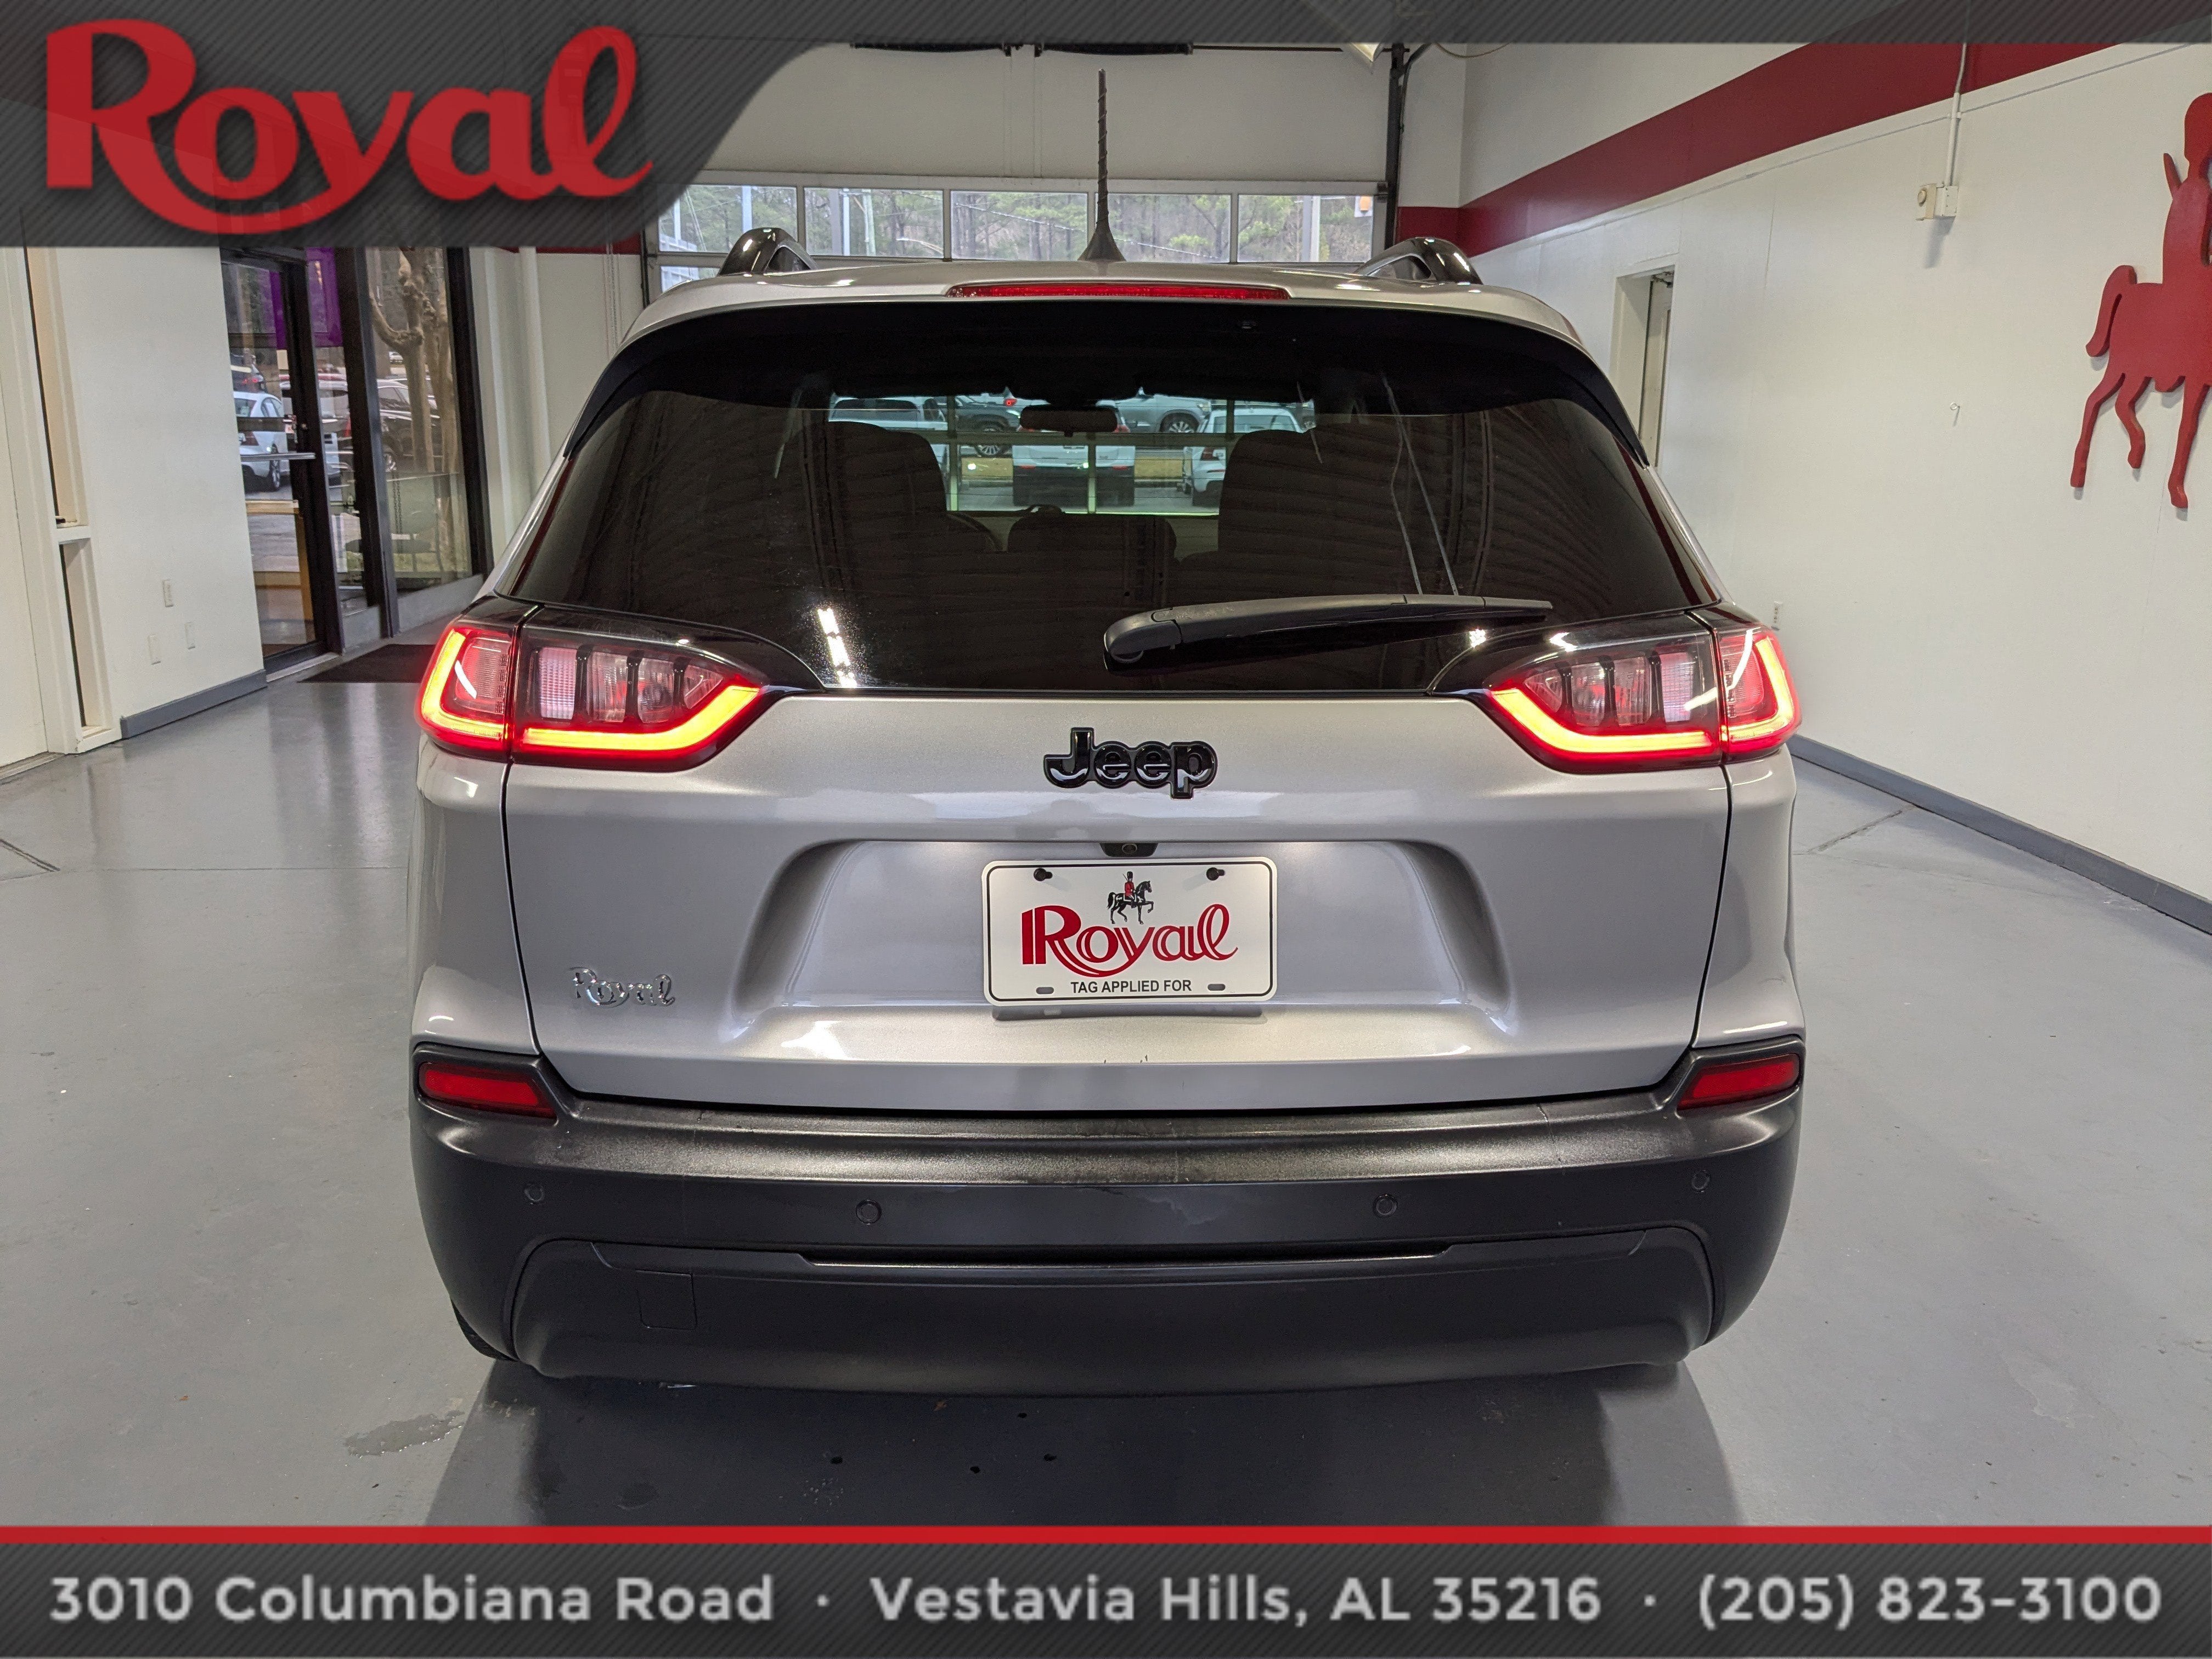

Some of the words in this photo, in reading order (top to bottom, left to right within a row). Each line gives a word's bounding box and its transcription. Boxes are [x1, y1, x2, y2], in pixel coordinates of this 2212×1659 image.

[1043, 727, 1218, 799] Jeep
[1022, 904, 1238, 978] Royal
[569, 967, 675, 1008] Royal
[1071, 981, 1098, 994] TAG
[1102, 980, 1160, 992] APPLIED
[1164, 980, 1192, 991] FOR
